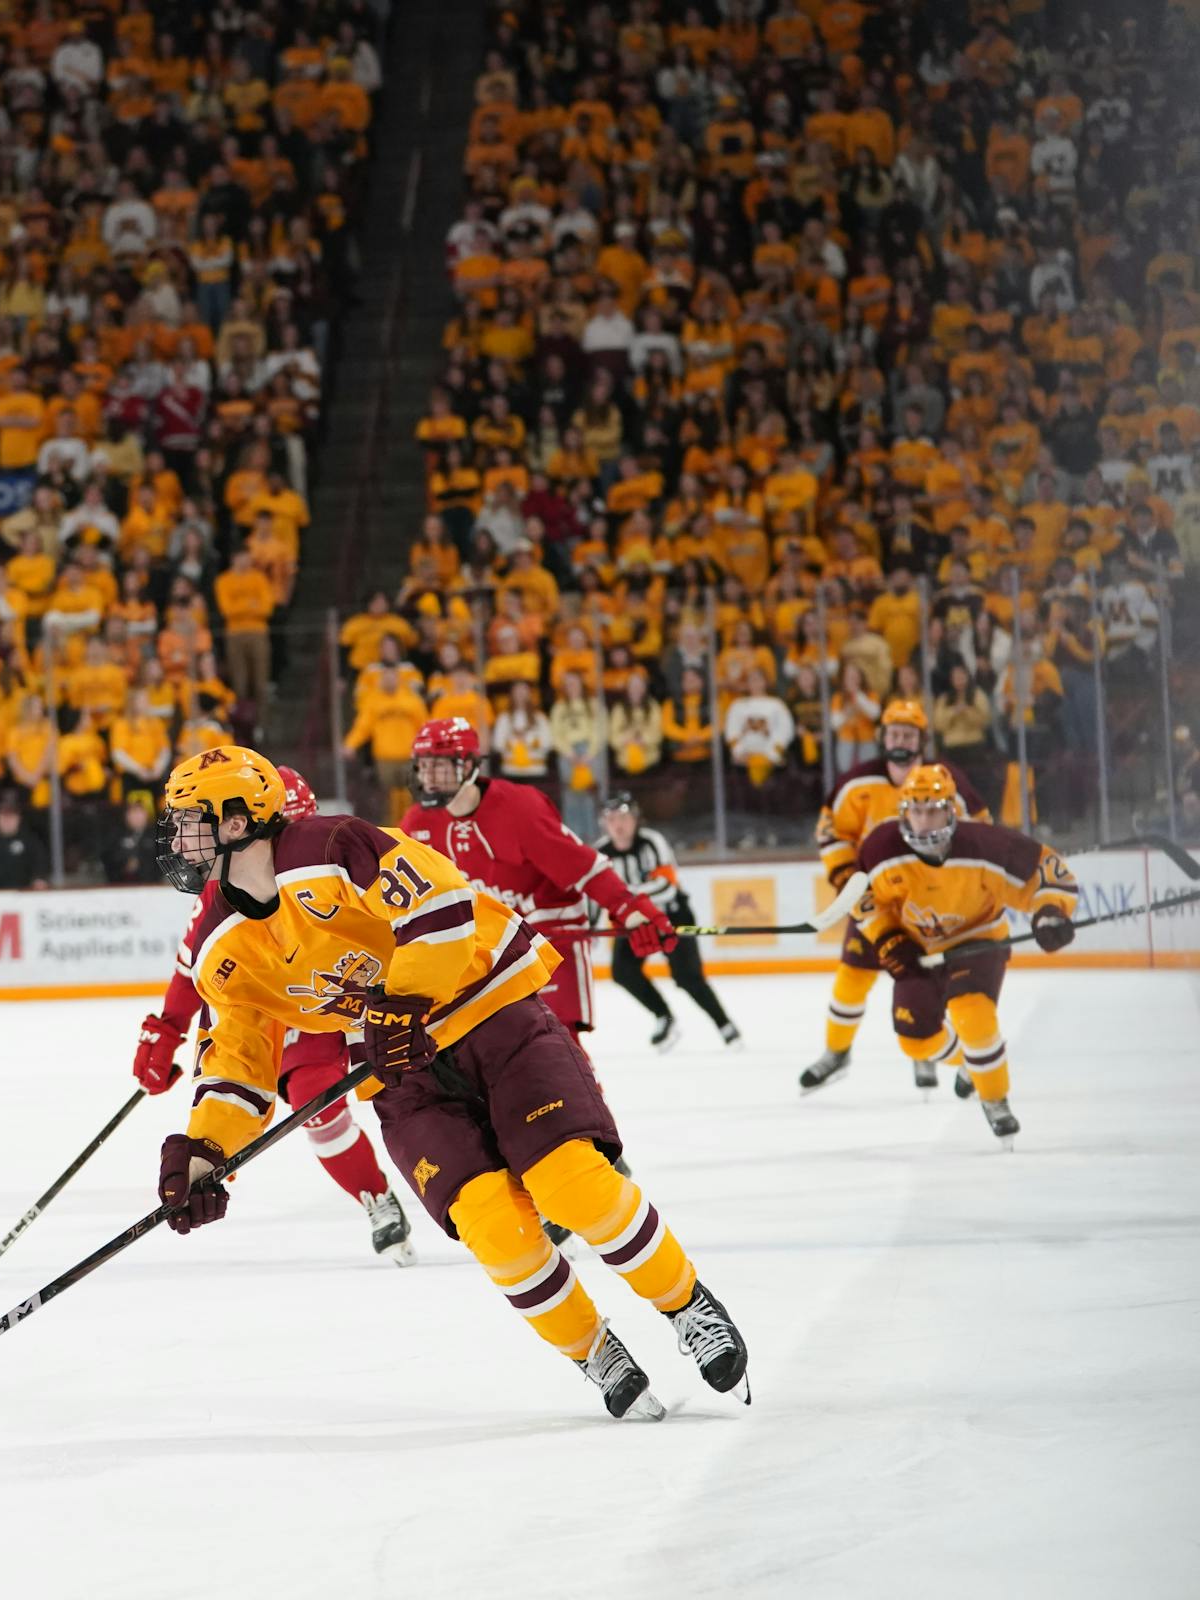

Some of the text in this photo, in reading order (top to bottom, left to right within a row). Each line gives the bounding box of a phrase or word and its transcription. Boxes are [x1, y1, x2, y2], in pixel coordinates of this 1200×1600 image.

[199, 749, 231, 769] M
[380, 855, 434, 910] 81
[38, 909, 141, 932] Science.
[41, 937, 133, 963] Applied
[138, 936, 165, 956] to
[336, 996, 363, 1014] M
[367, 1010, 413, 1027] CM
[526, 1099, 564, 1123] CCM
[0, 1204, 42, 1252] CCM
